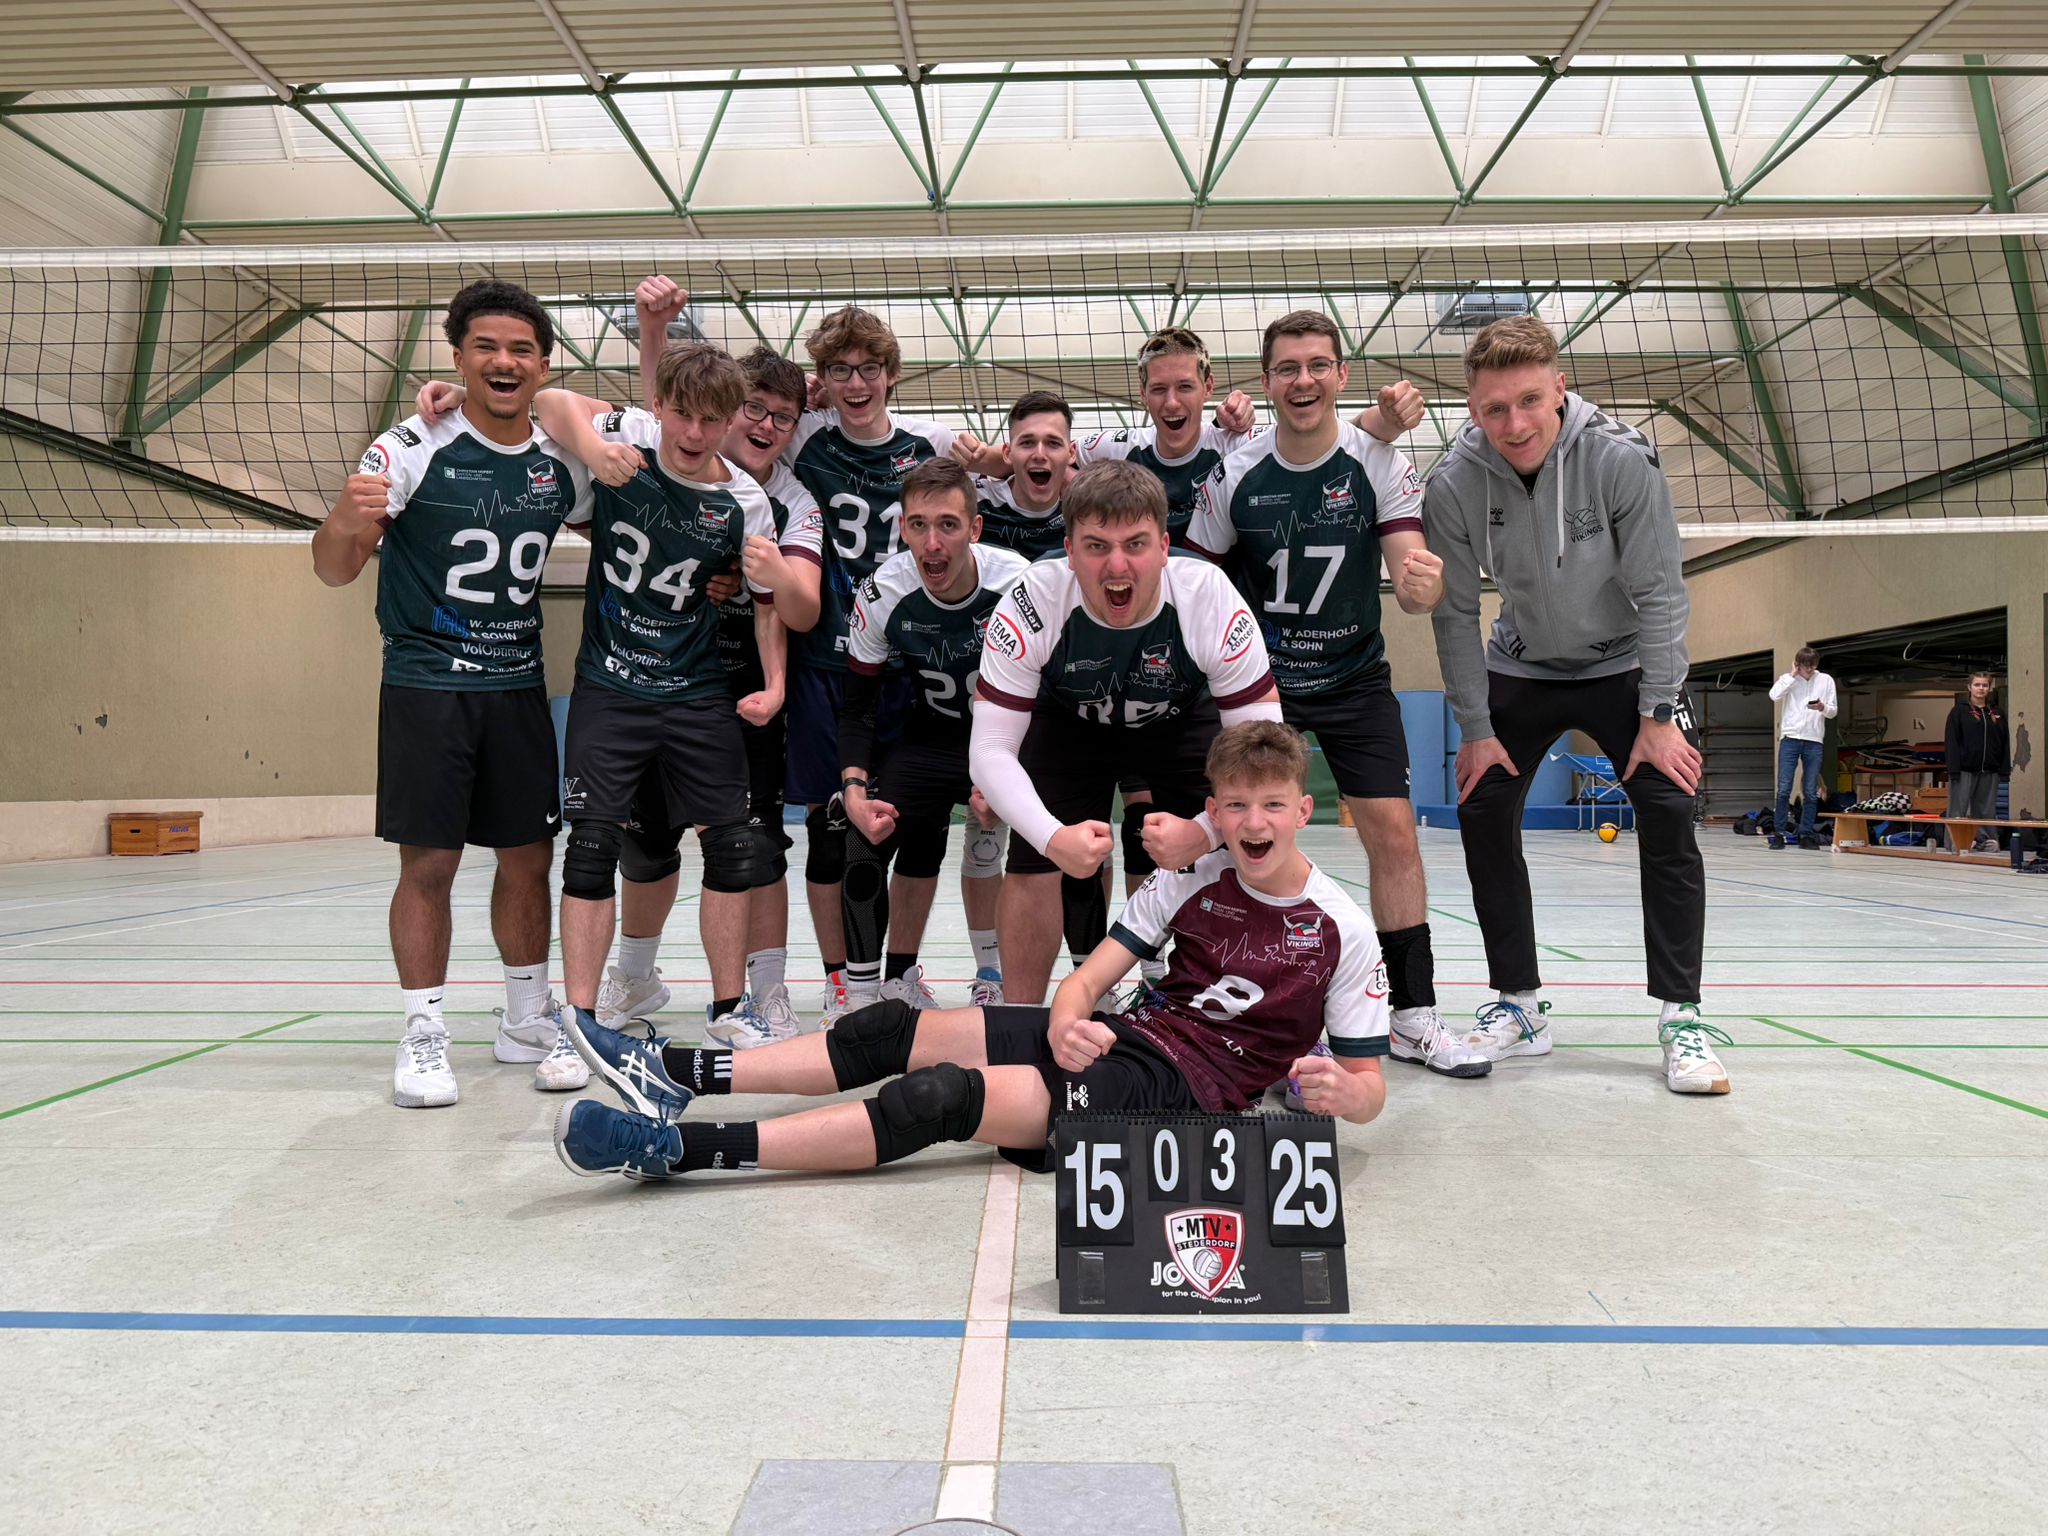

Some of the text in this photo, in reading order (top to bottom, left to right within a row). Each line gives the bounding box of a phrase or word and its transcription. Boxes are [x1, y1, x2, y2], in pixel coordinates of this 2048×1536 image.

[364, 451, 382, 466] MA
[531, 486, 557, 494] VIKINGS
[1326, 499, 1353, 510] VIKINGS
[829, 493, 903, 563] 31
[1571, 524, 1604, 543] VIKINGS
[445, 528, 548, 605] 29
[603, 521, 701, 611] 34
[1264, 545, 1346, 615] 17
[620, 606, 696, 627] W. ADERHD
[1014, 587, 1041, 629] Goslar
[469, 616, 536, 630] W. ADERHO
[630, 623, 661, 638] SOHN
[1226, 616, 1250, 646] TEMA
[1282, 625, 1358, 639] W. ADERHOLD
[481, 632, 517, 640] SOHN
[991, 616, 1017, 652] TEMA
[1281, 640, 1323, 651] & SOHN
[576, 840, 599, 849] ALLSIX
[1286, 940, 1320, 948] VIKINGS
[693, 1049, 703, 1089] adidas
[1065, 1081, 1074, 1111] hummel
[1154, 1128, 1179, 1192] 0
[1211, 1128, 1236, 1191] 3
[1065, 1141, 1125, 1230] 15
[1270, 1139, 1337, 1228] 25
[1186, 1217, 1222, 1238] MTV
[1176, 1239, 1236, 1251] STEDERDORF
[1150, 1261, 1246, 1289] JOA
[1190, 1291, 1233, 1304] Chapion
[1243, 1293, 1262, 1304] you!
